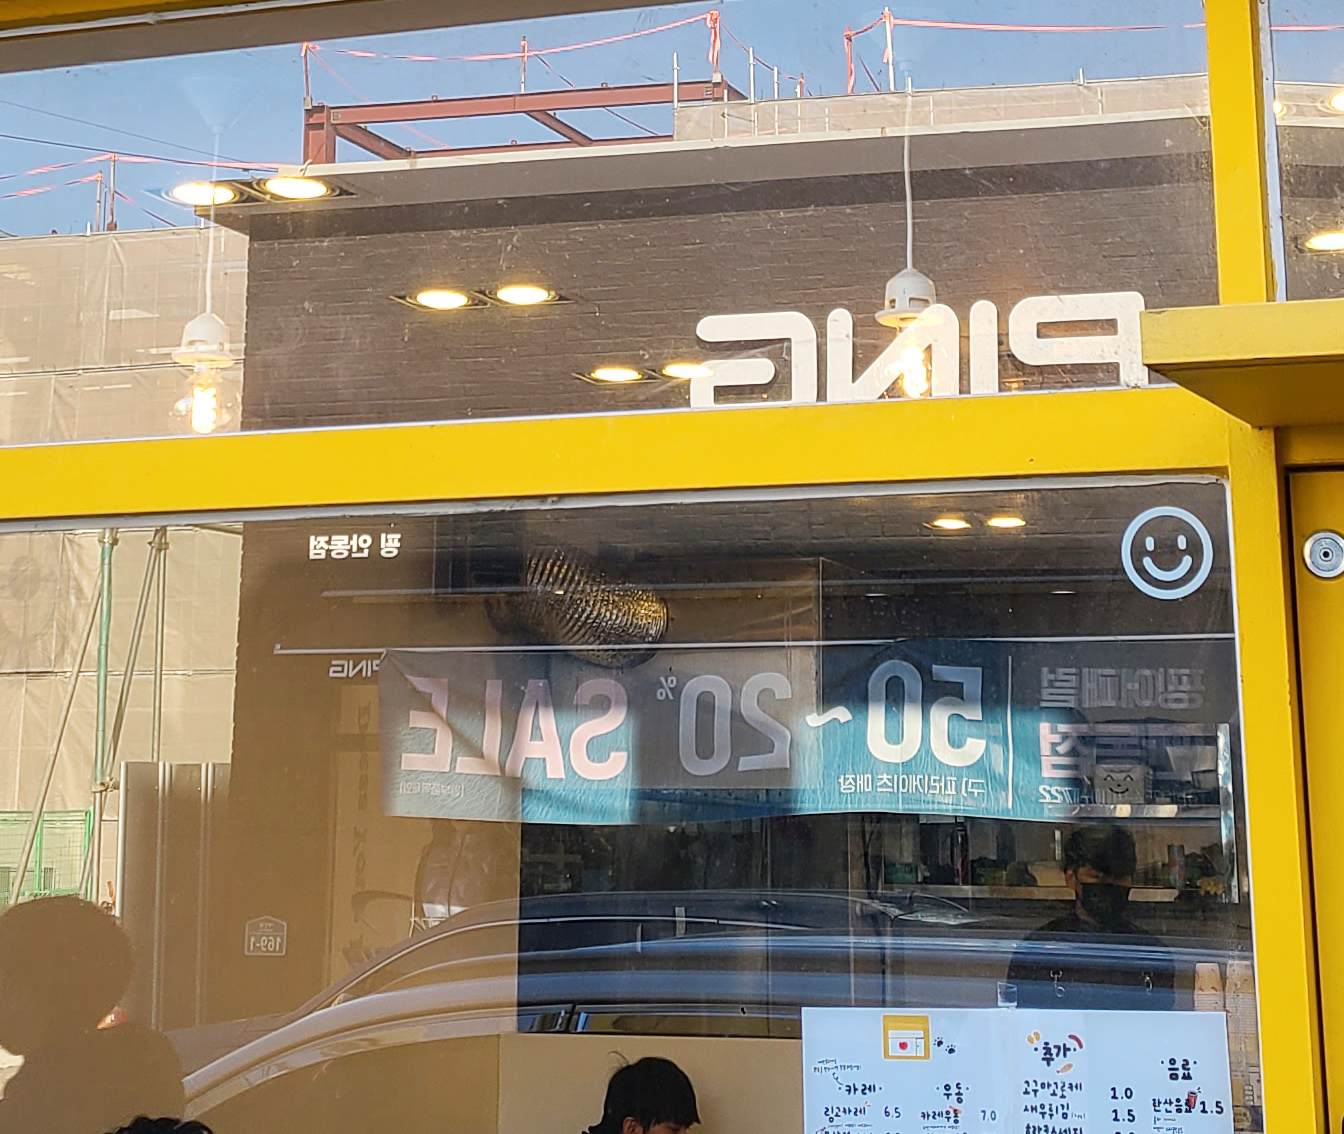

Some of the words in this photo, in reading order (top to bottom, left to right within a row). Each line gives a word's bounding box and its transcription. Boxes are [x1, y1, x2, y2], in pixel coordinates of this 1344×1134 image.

[1041, 1041, 1071, 1067] 추가
[1168, 1057, 1193, 1081] 음료
[844, 1082, 877, 1096] 카레
[943, 1082, 964, 1104] 우동
[1110, 1086, 1134, 1100] 1.0
[823, 1105, 866, 1124] 링고카레
[884, 1105, 902, 1119] 6.5
[1112, 1108, 1136, 1123] 1.5
[1199, 1100, 1225, 1115] 1.5
[920, 1109, 960, 1125] 카레우동
[980, 1109, 997, 1121] 7.0
